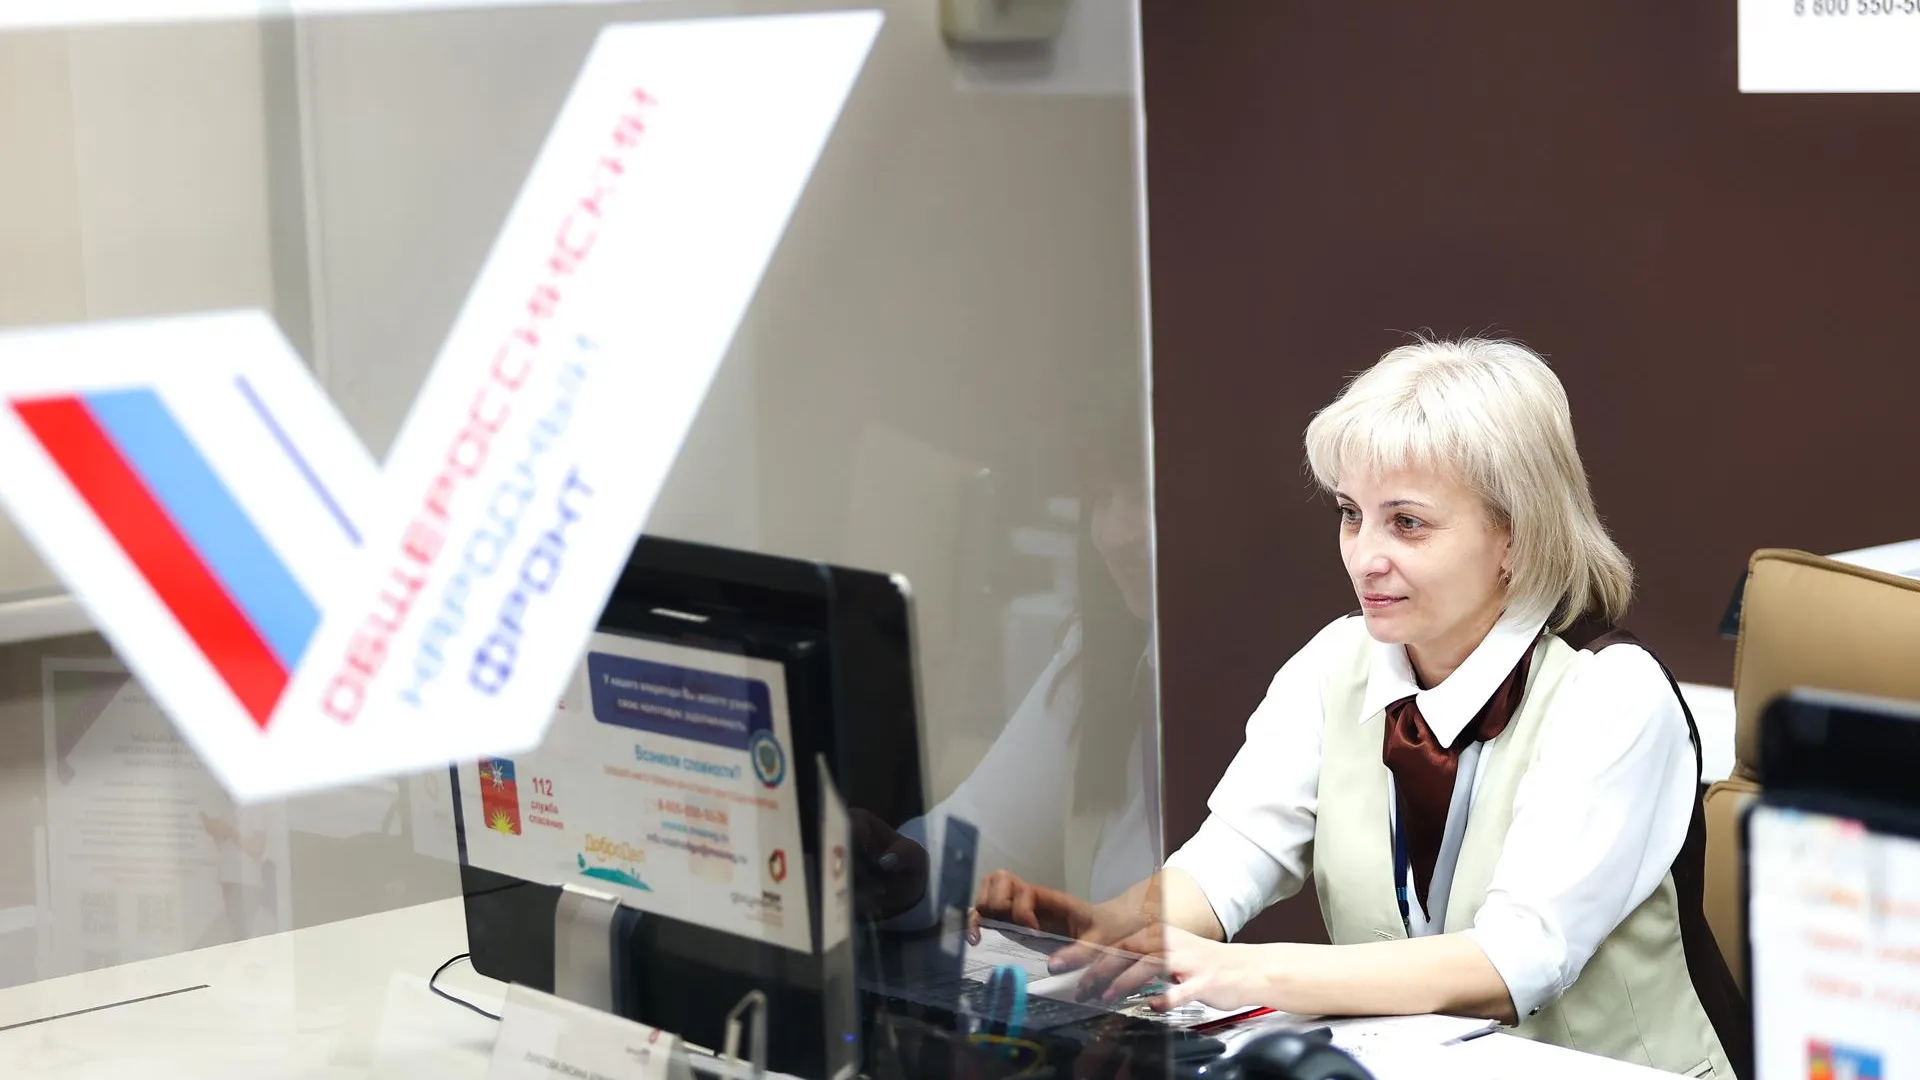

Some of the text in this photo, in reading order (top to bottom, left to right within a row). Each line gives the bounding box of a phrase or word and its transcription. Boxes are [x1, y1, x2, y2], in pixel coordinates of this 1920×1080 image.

[1794, 0, 1805, 16] 8
[1812, 0, 1850, 16] 800
[467, 462, 596, 698] ФРОНТ
[532, 777, 554, 797] 112
[530, 800, 558, 814] служба
[529, 814, 564, 830] спасения
